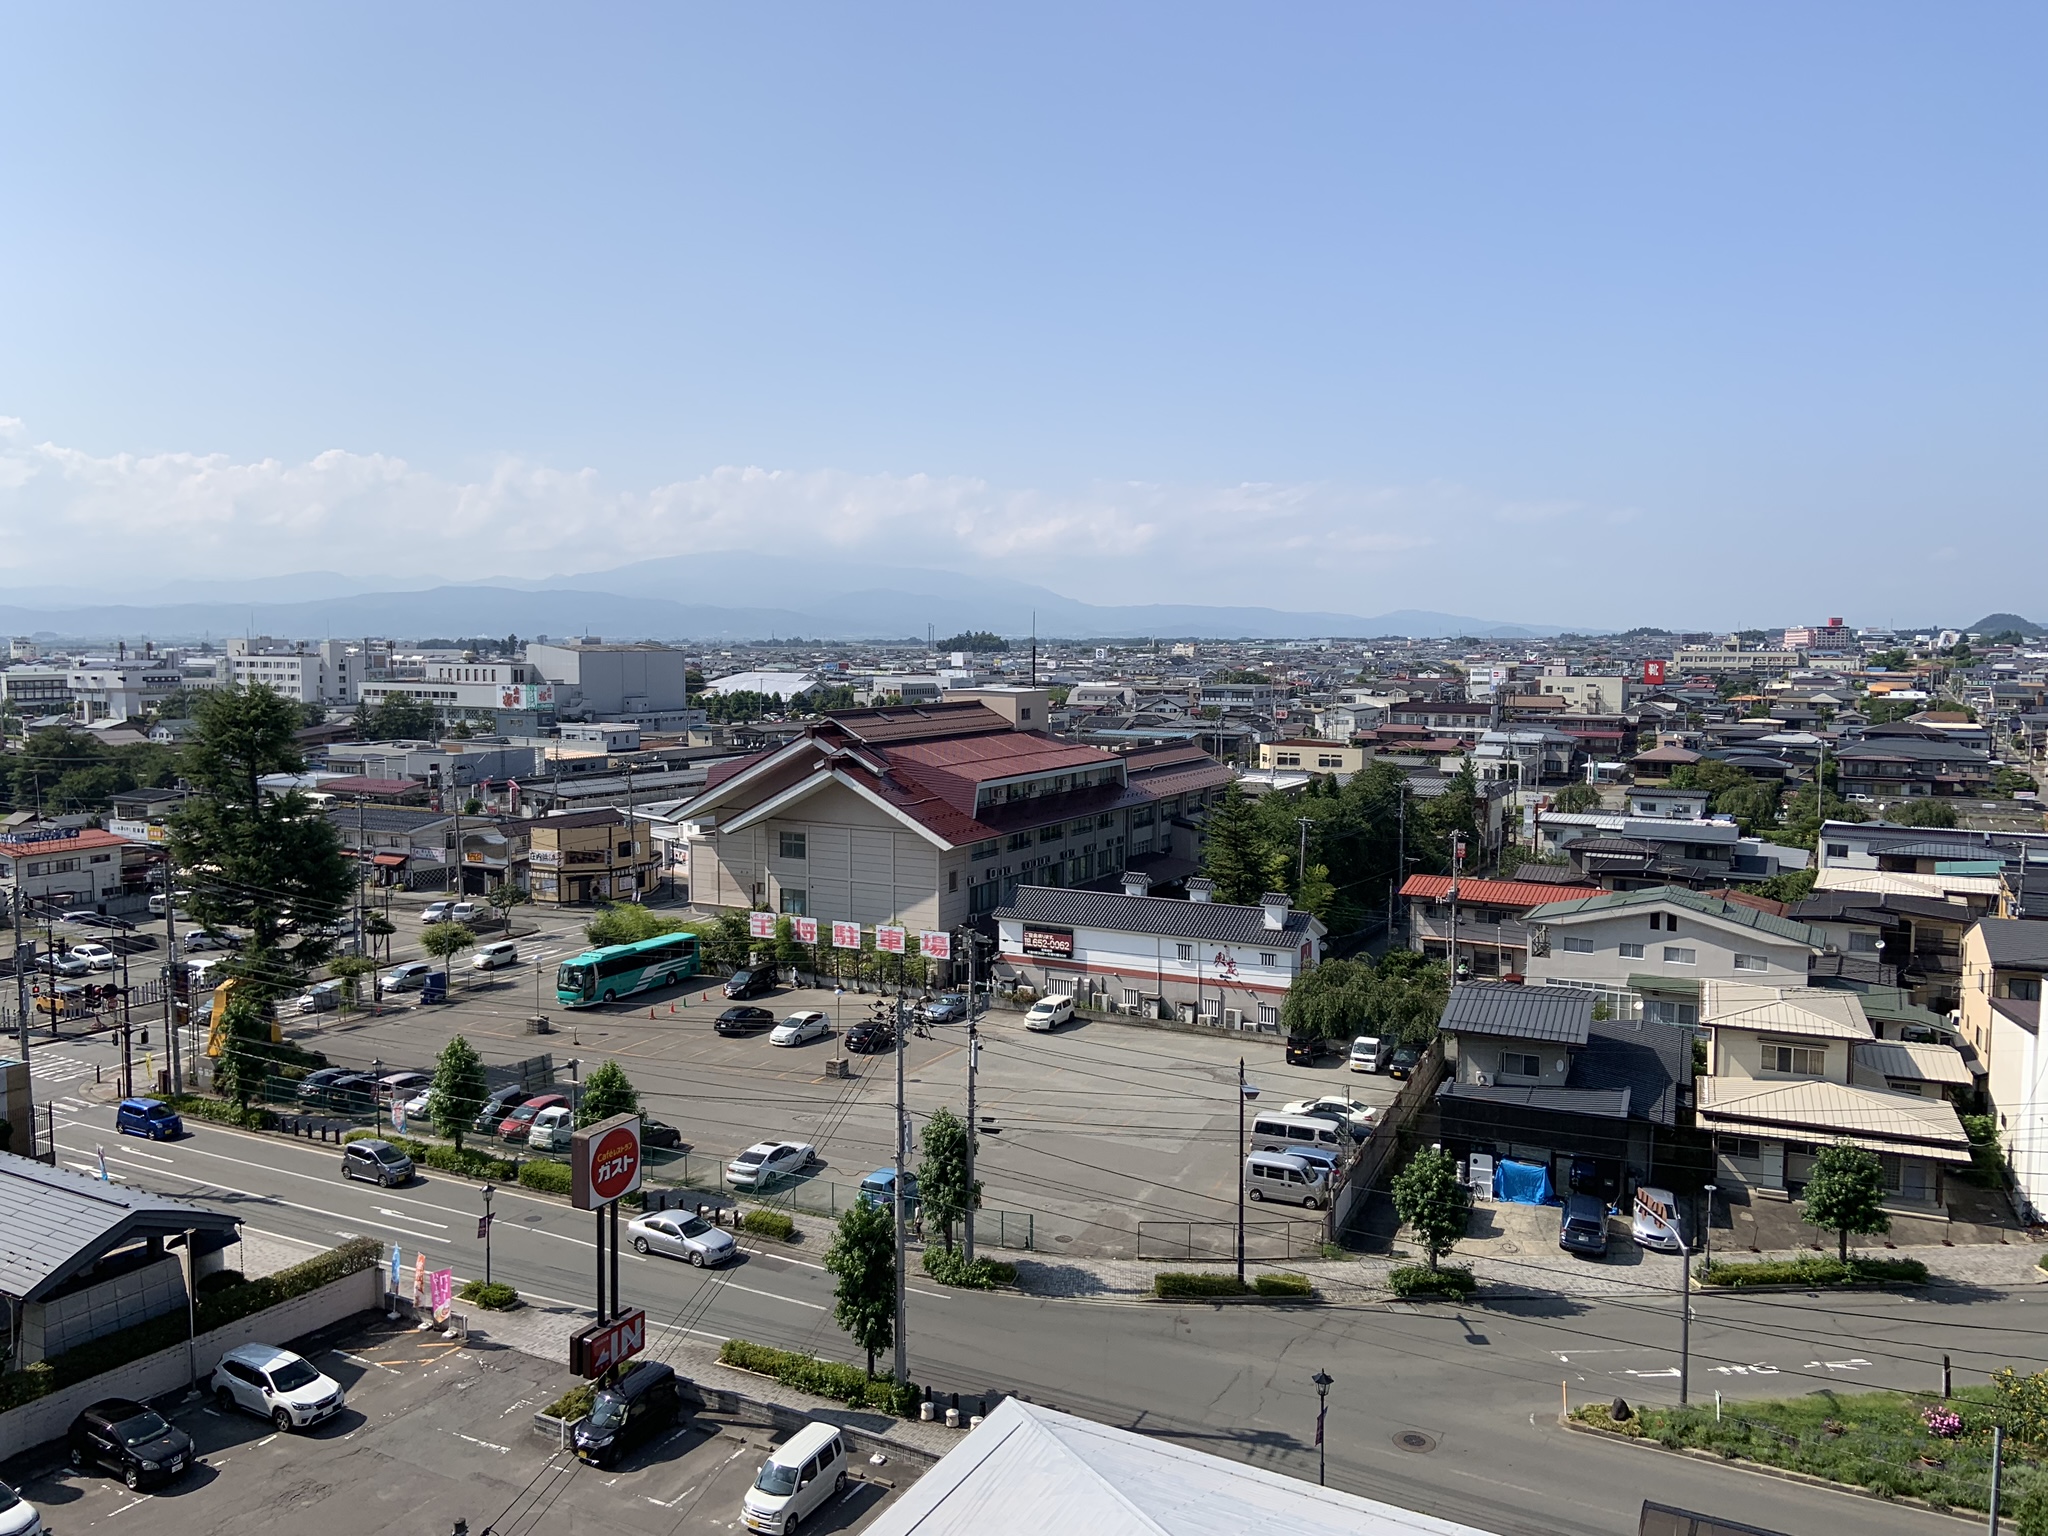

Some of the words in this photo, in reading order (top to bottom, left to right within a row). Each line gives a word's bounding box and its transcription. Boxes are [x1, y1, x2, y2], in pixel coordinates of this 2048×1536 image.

[1032, 939, 1070, 950] 652-0062
[597, 1154, 634, 1184] ガスト
[610, 1317, 642, 1363] IN
